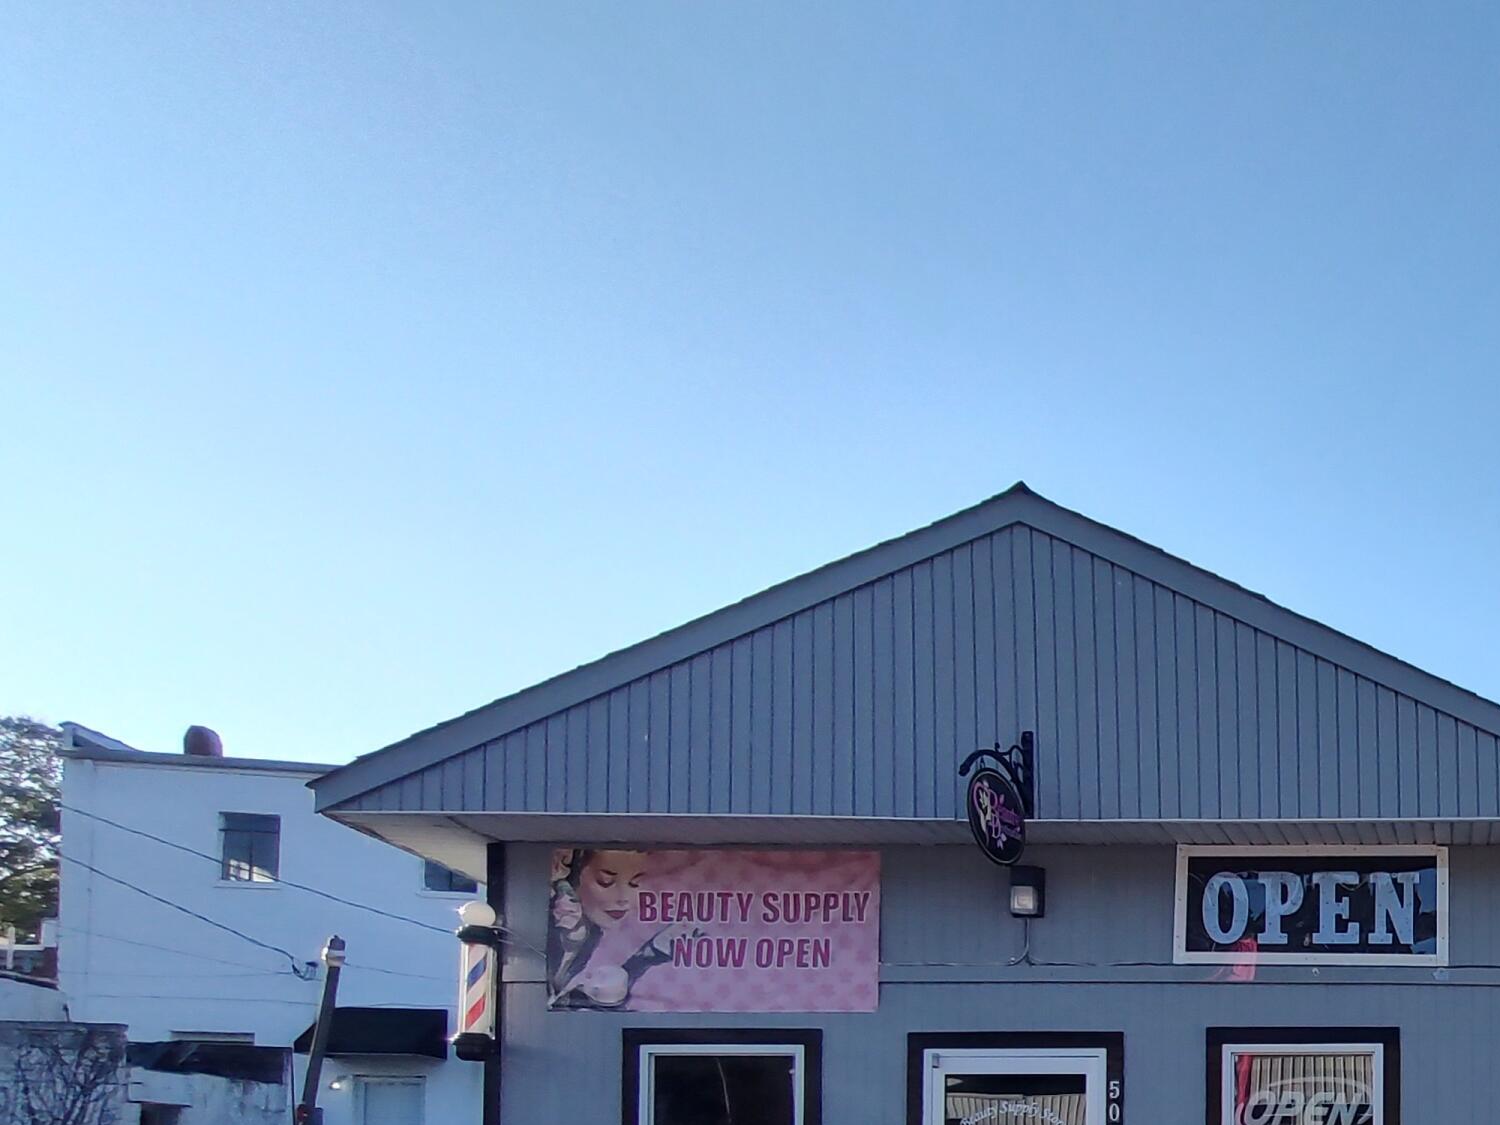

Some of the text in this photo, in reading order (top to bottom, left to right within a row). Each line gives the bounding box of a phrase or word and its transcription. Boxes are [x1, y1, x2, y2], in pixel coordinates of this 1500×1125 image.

[638, 891, 871, 924] BEAUTY SUPPLY
[1202, 871, 1420, 945] OPEN
[673, 937, 832, 969] NOW OPEN
[999, 1101, 1040, 1118] Supply
